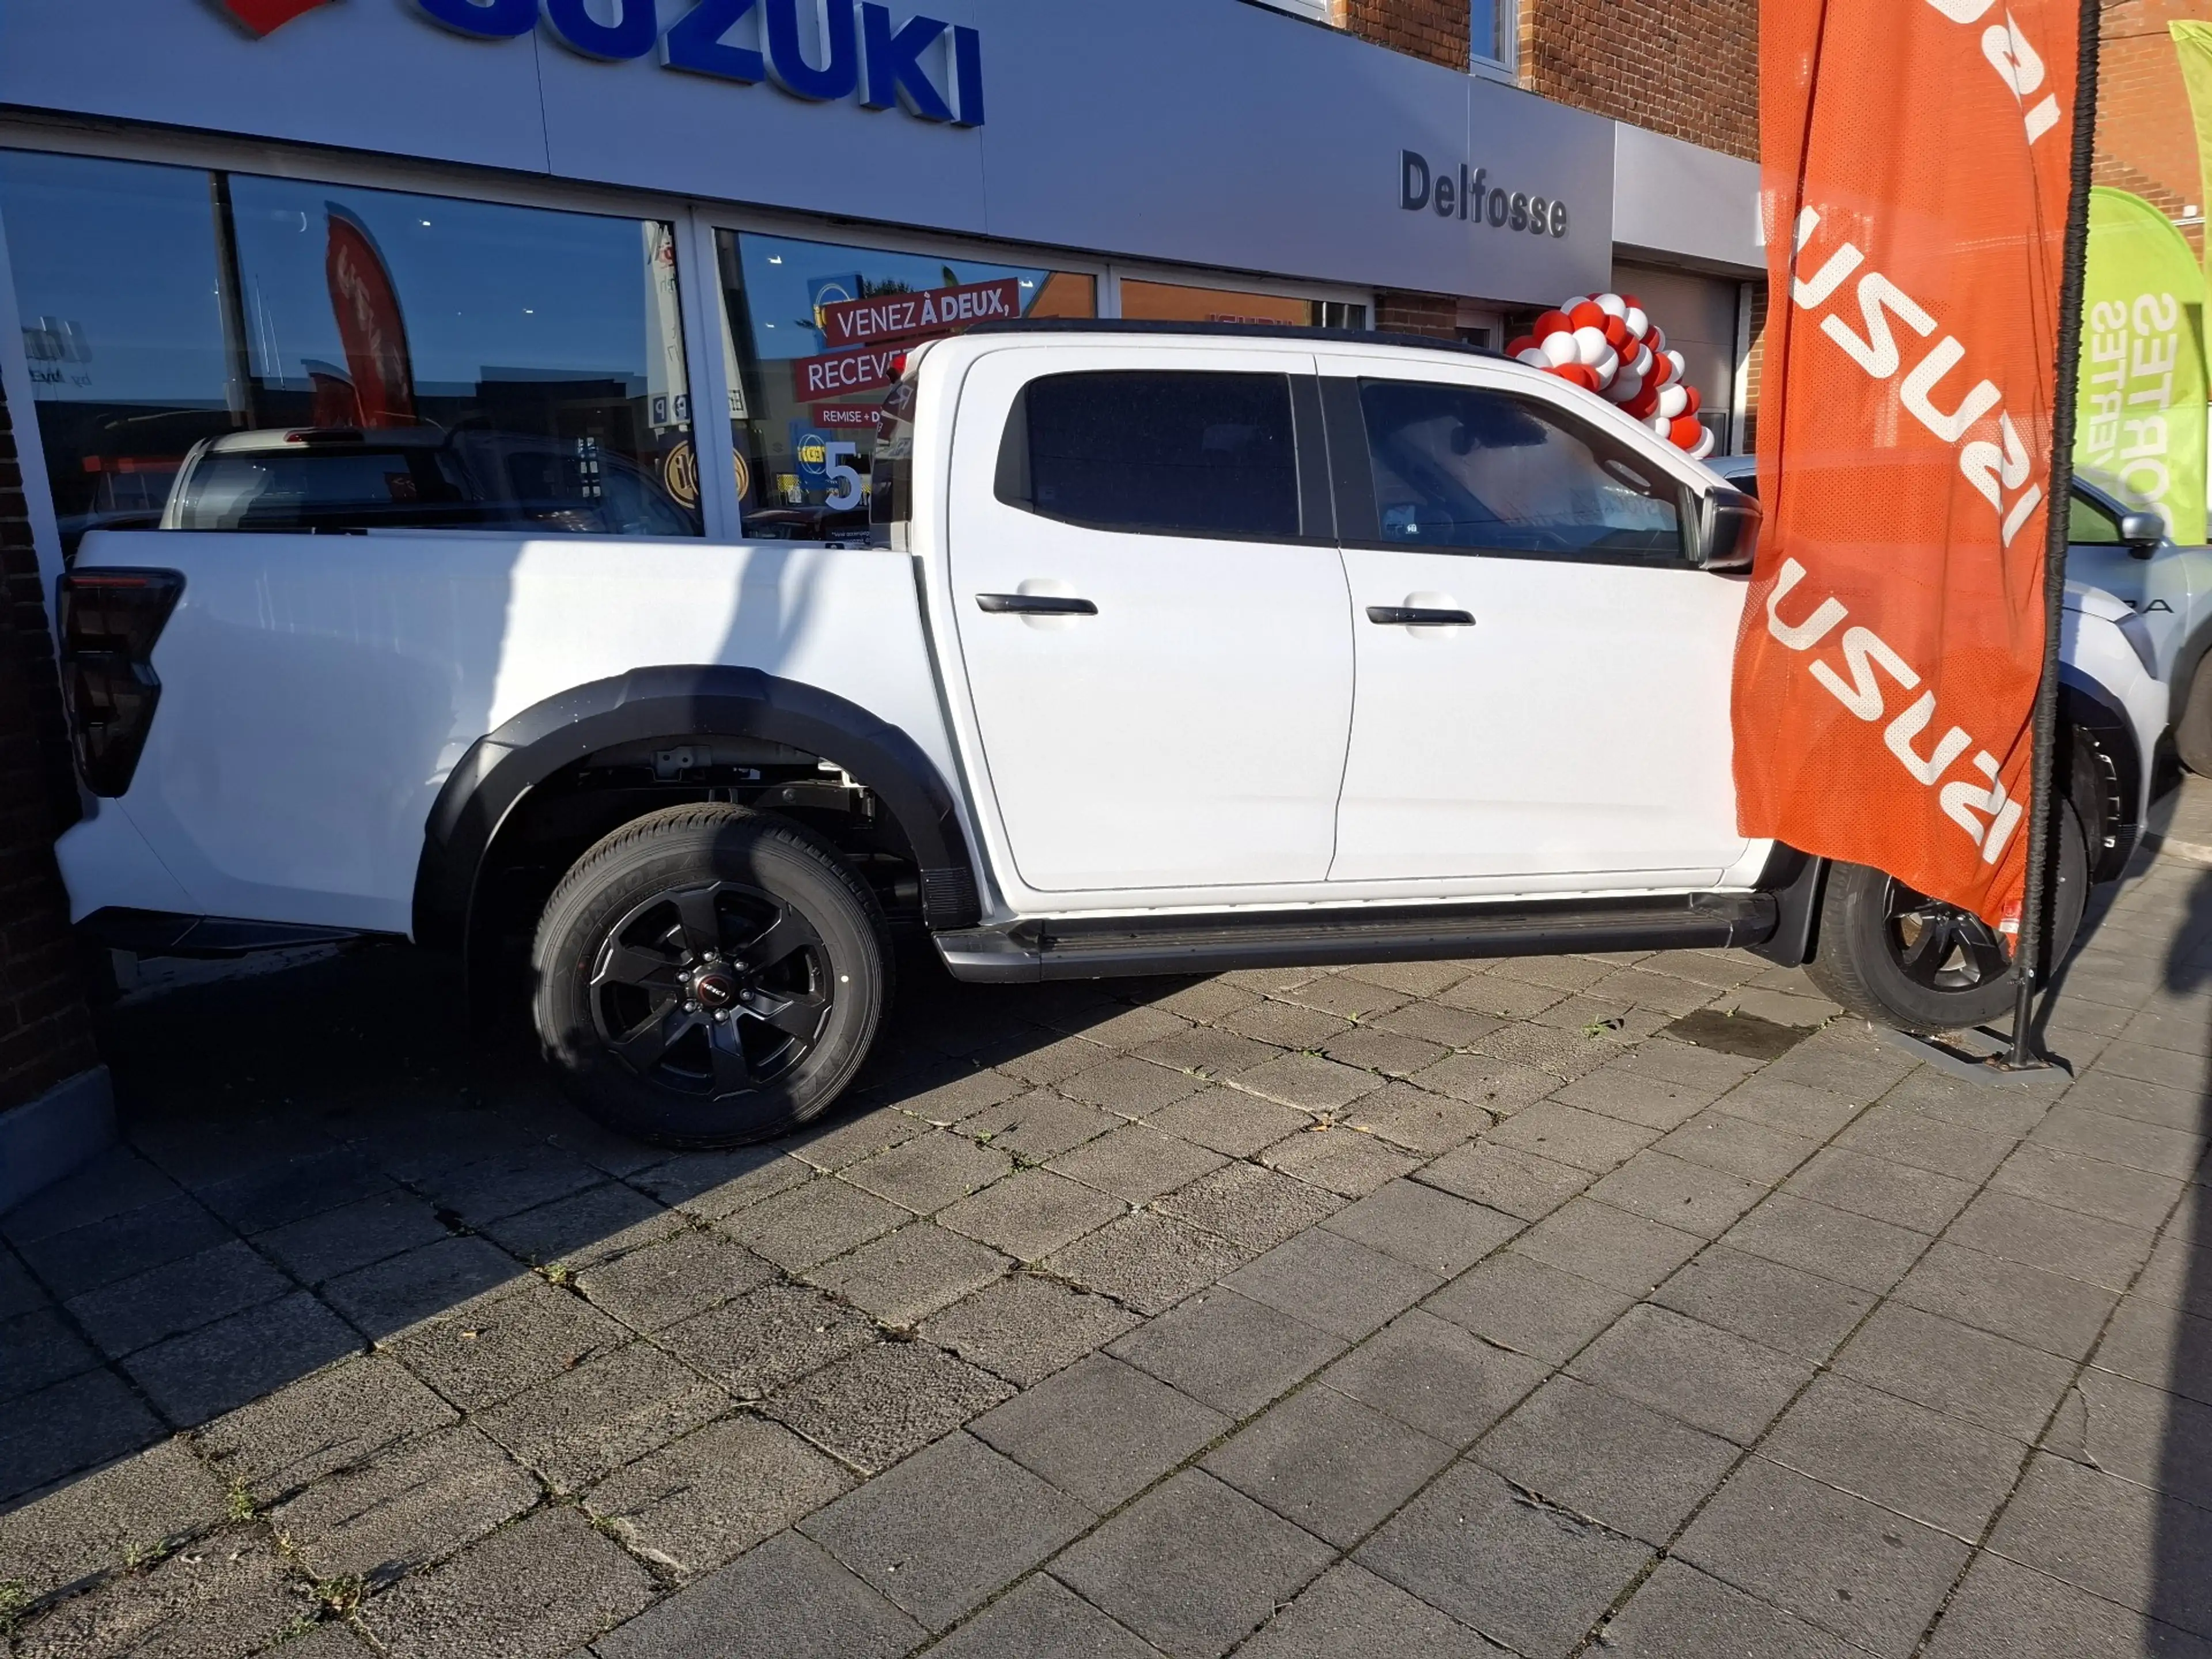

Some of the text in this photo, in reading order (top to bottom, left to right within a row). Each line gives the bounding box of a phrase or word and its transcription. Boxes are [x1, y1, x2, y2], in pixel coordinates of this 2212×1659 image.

[1399, 149, 1569, 238] Delfosse
[838, 302, 916, 337] VENEZ
[921, 291, 937, 325] À
[941, 288, 1009, 321] DEUX,
[823, 411, 862, 422] REMISE
